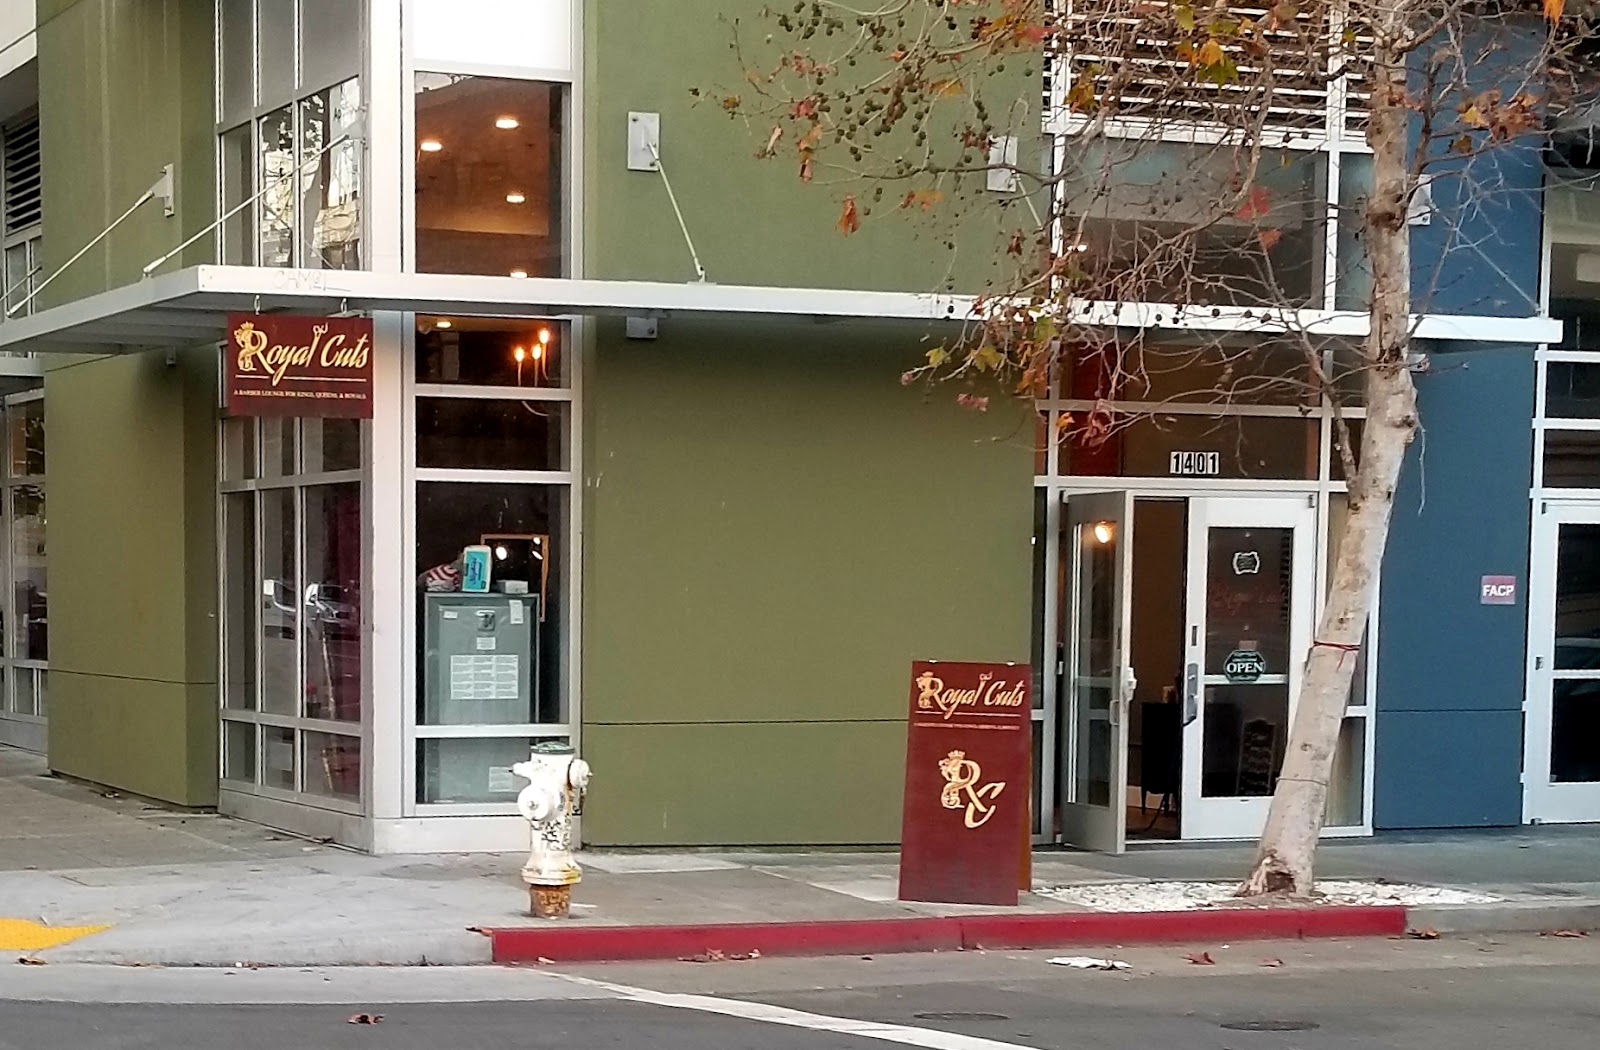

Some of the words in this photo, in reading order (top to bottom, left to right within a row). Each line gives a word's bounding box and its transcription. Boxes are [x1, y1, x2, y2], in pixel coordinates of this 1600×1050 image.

[233, 321, 328, 386] Royal
[320, 333, 369, 368] Cuts
[1172, 452, 1217, 473] 1401
[1482, 584, 1515, 597] FACP
[1226, 662, 1265, 674] OPEN
[915, 671, 993, 720] Royal
[984, 680, 1025, 707] Cuts
